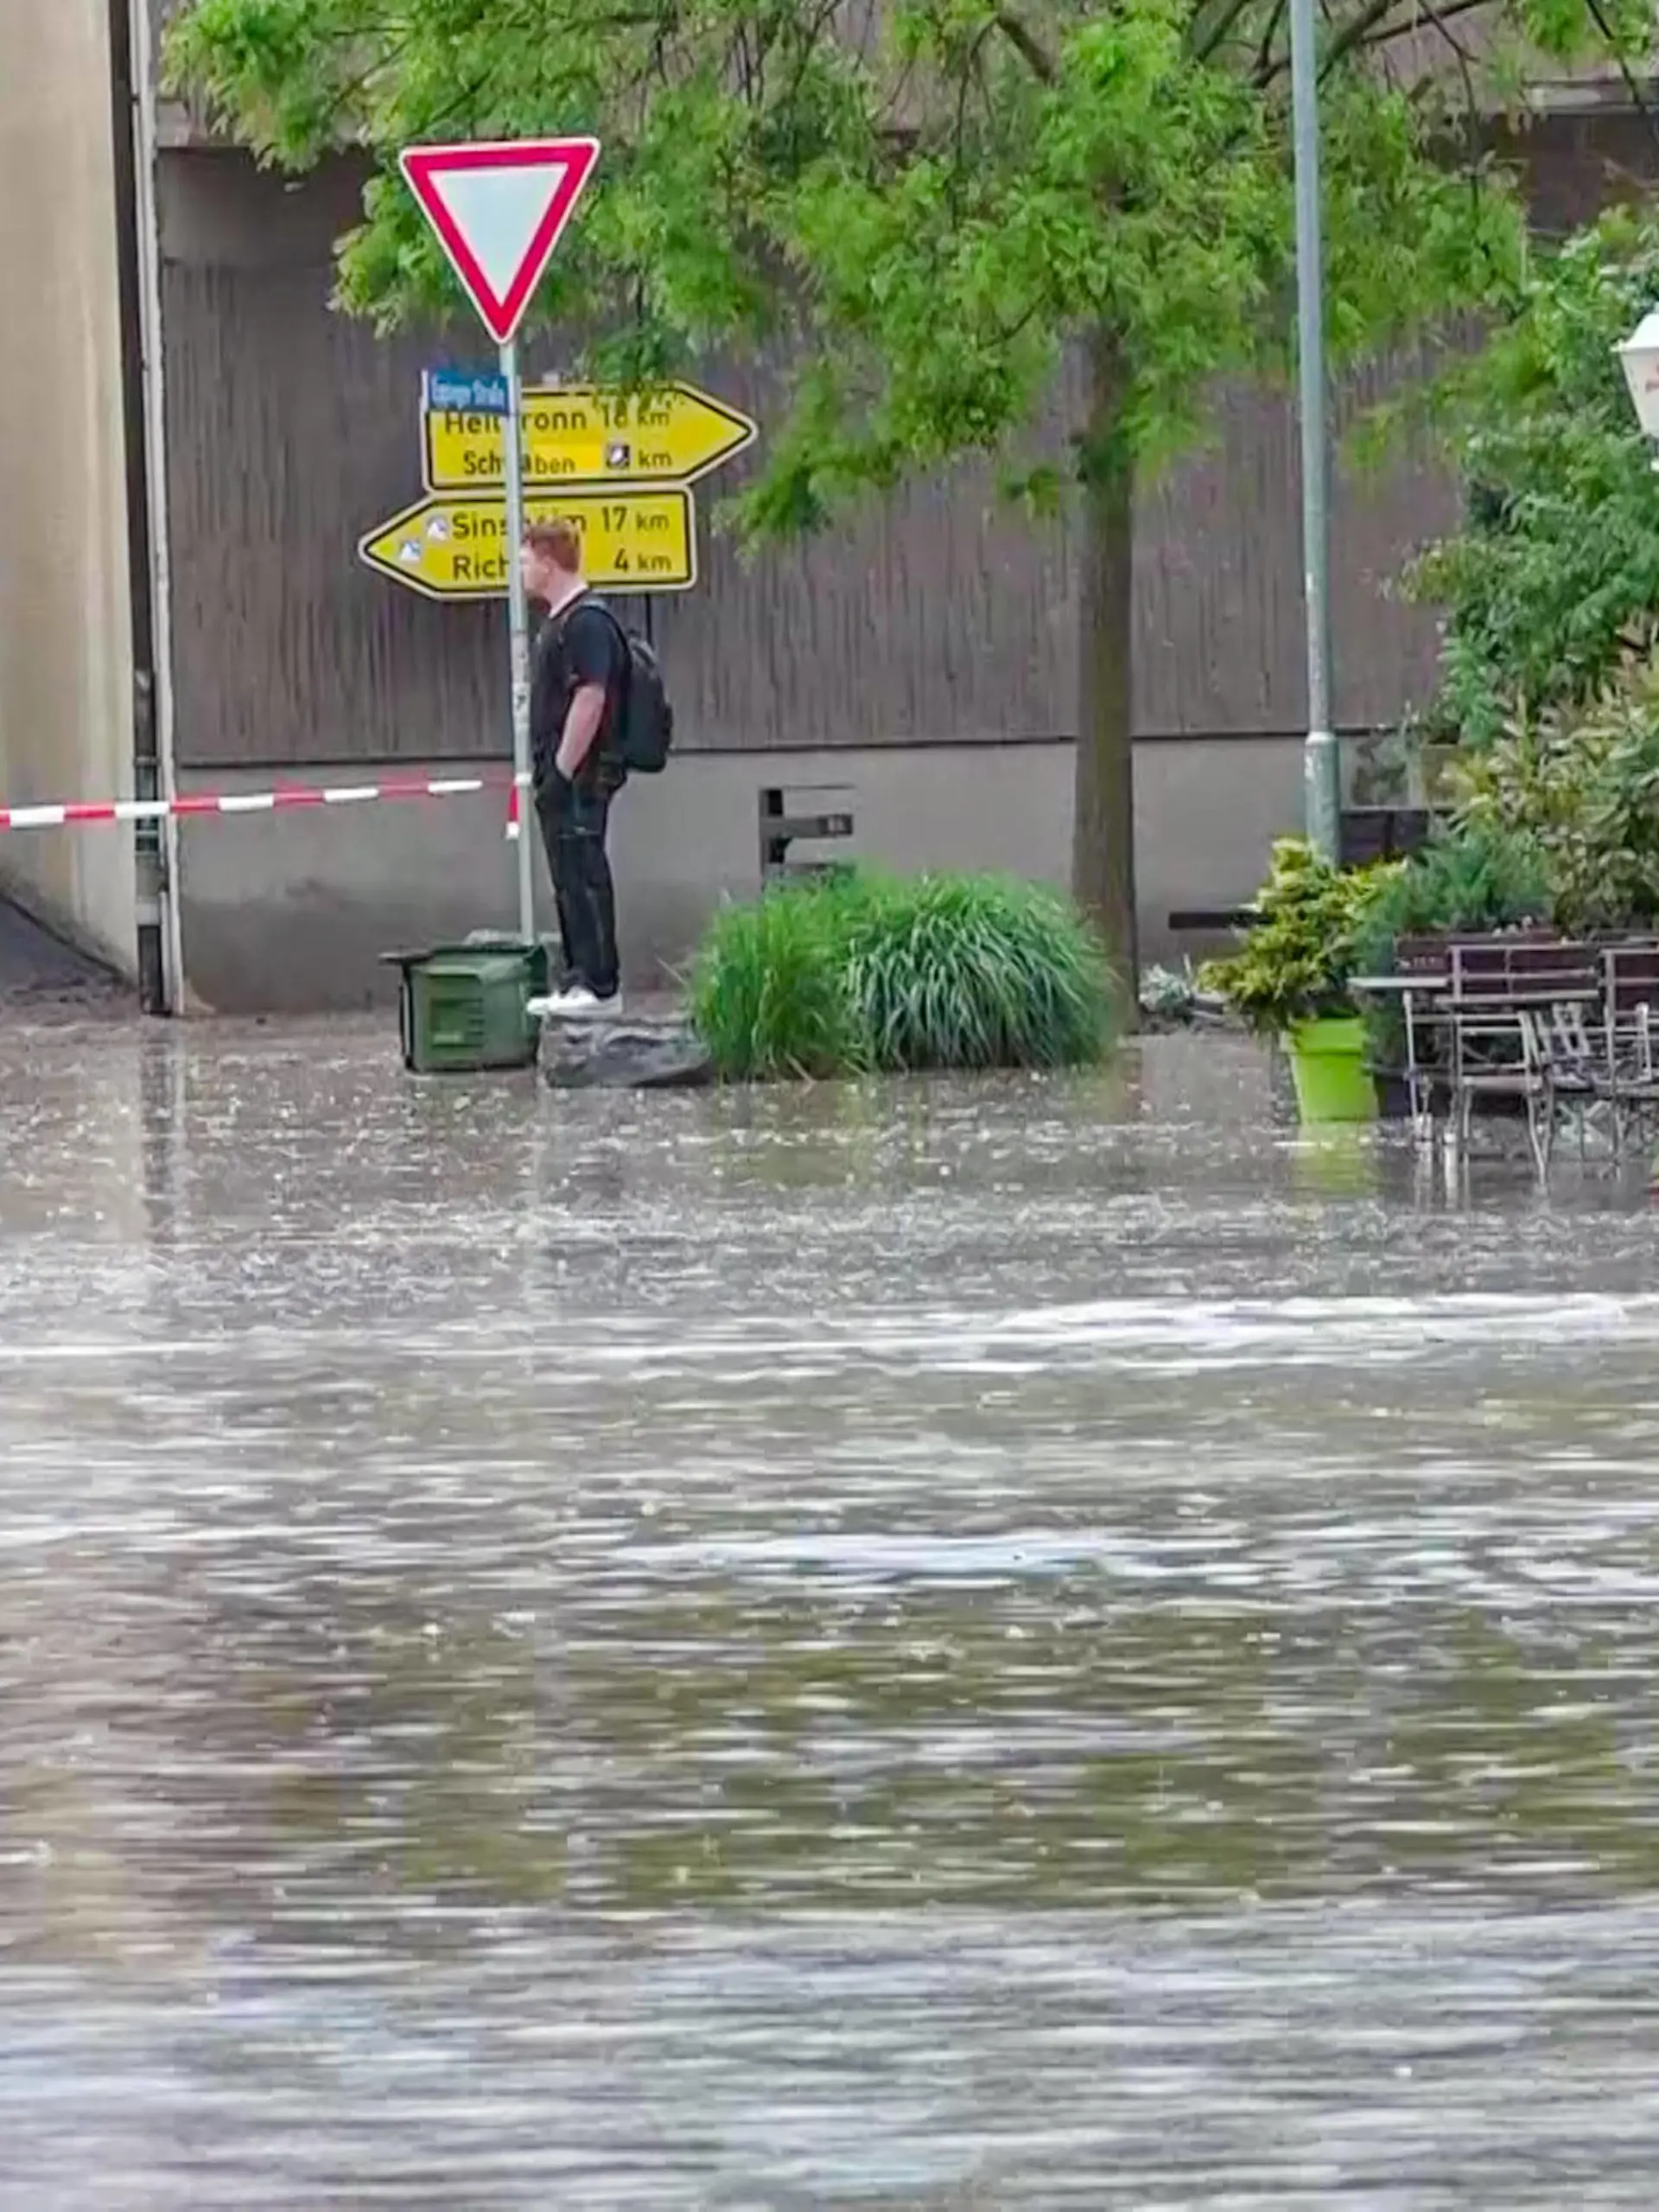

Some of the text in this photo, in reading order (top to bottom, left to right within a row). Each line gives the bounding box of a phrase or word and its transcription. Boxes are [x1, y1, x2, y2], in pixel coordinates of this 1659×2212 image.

[445, 410, 587, 435] Heilronn
[463, 449, 672, 476] Schaben km
[601, 506, 627, 533] 17
[636, 512, 670, 533] km
[613, 547, 629, 573] 4
[637, 551, 672, 573] km
